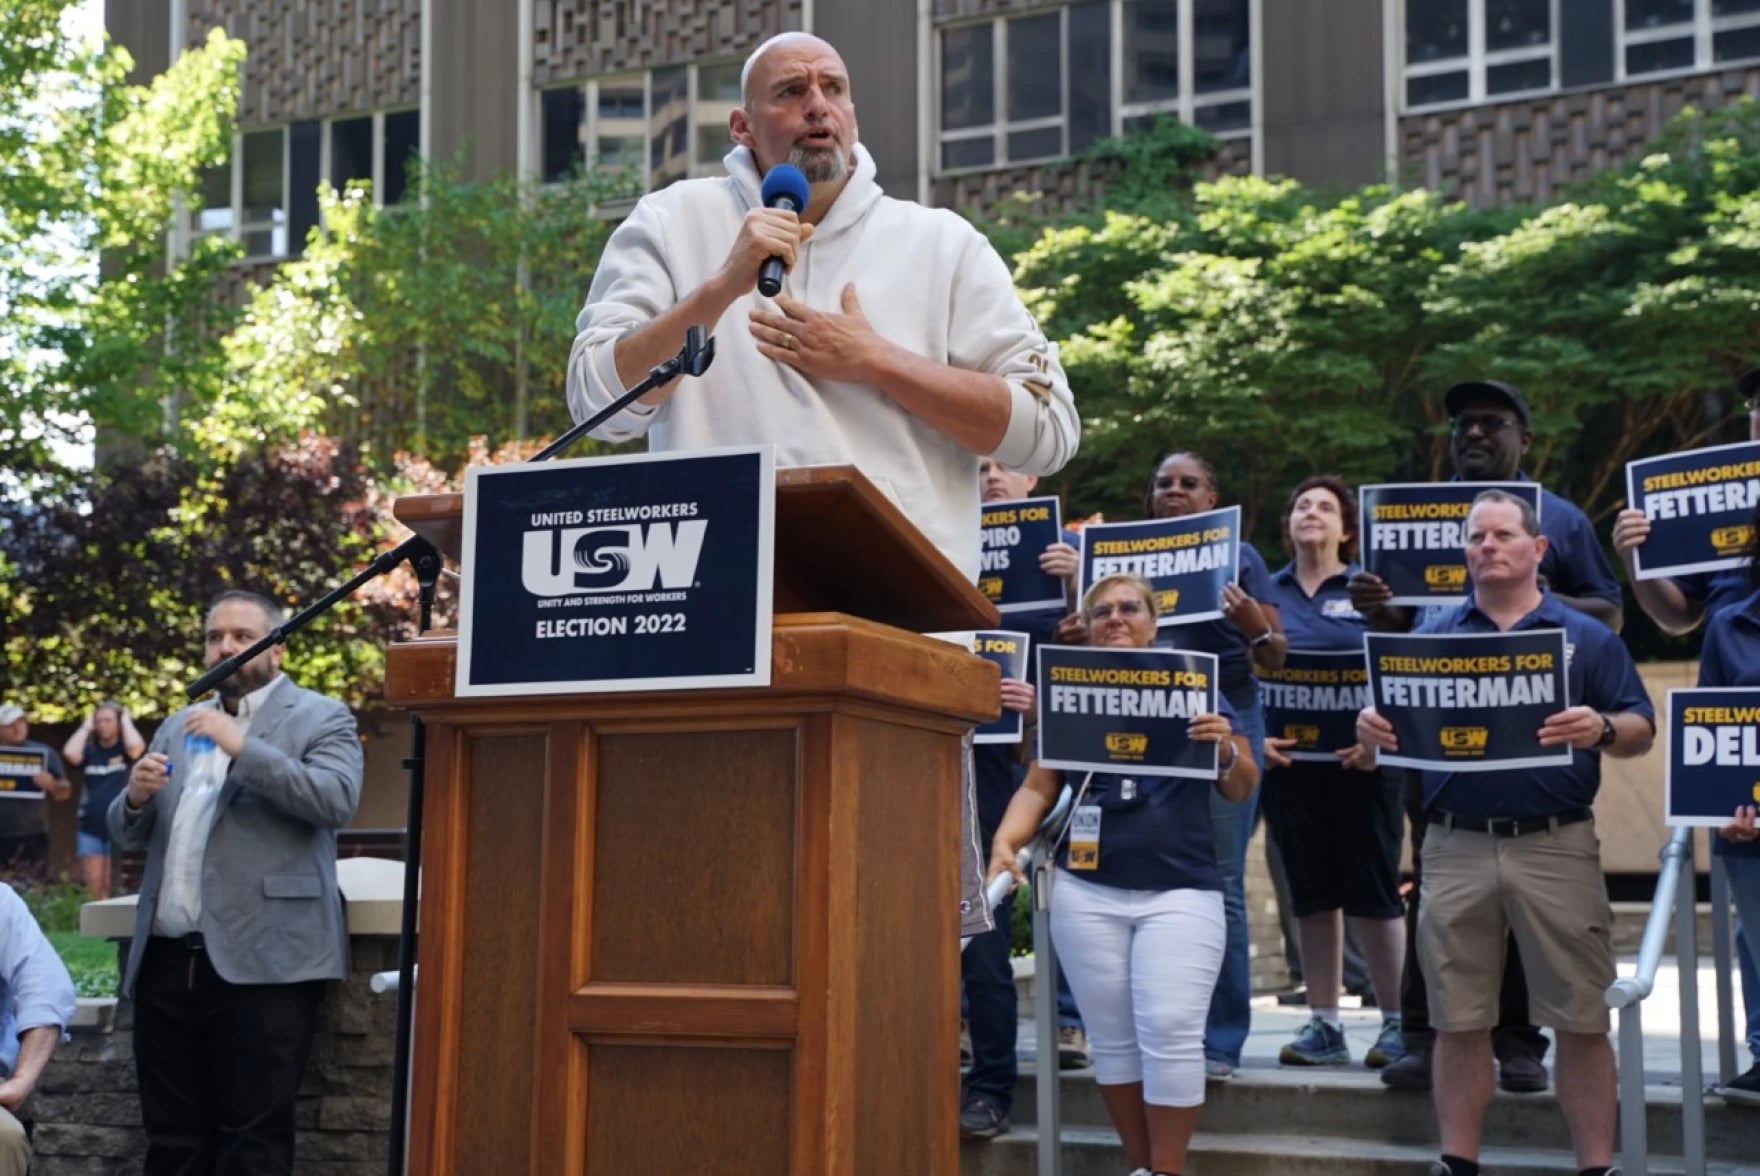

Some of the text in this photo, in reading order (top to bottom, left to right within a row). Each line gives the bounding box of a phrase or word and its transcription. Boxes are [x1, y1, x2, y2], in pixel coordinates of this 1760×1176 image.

[531, 502, 698, 526] UNITED STEELWORKERS
[1019, 507, 1049, 522] FOR
[1371, 503, 1470, 519] STEELWORKE
[980, 526, 1021, 548] PIRO
[1093, 527, 1230, 555] STEELWORKERS FOR
[1371, 521, 1467, 550] FETTER
[521, 519, 709, 597] USW
[1092, 542, 1230, 582] FETTERMAN
[1425, 566, 1467, 585] USW
[537, 591, 687, 609] UNITY AND STRENGTH FOR WORKERS
[536, 613, 686, 638] ELECTION 2022
[1379, 655, 1511, 673] STEELWORKERS
[1515, 653, 1553, 671] FOR
[1051, 666, 1208, 687] STEELWORKERS FOR
[1380, 673, 1555, 708] FETTERMAN
[1051, 685, 1207, 719] FETTERMAN
[1105, 733, 1148, 753] USW
[1440, 727, 1488, 748] USW
